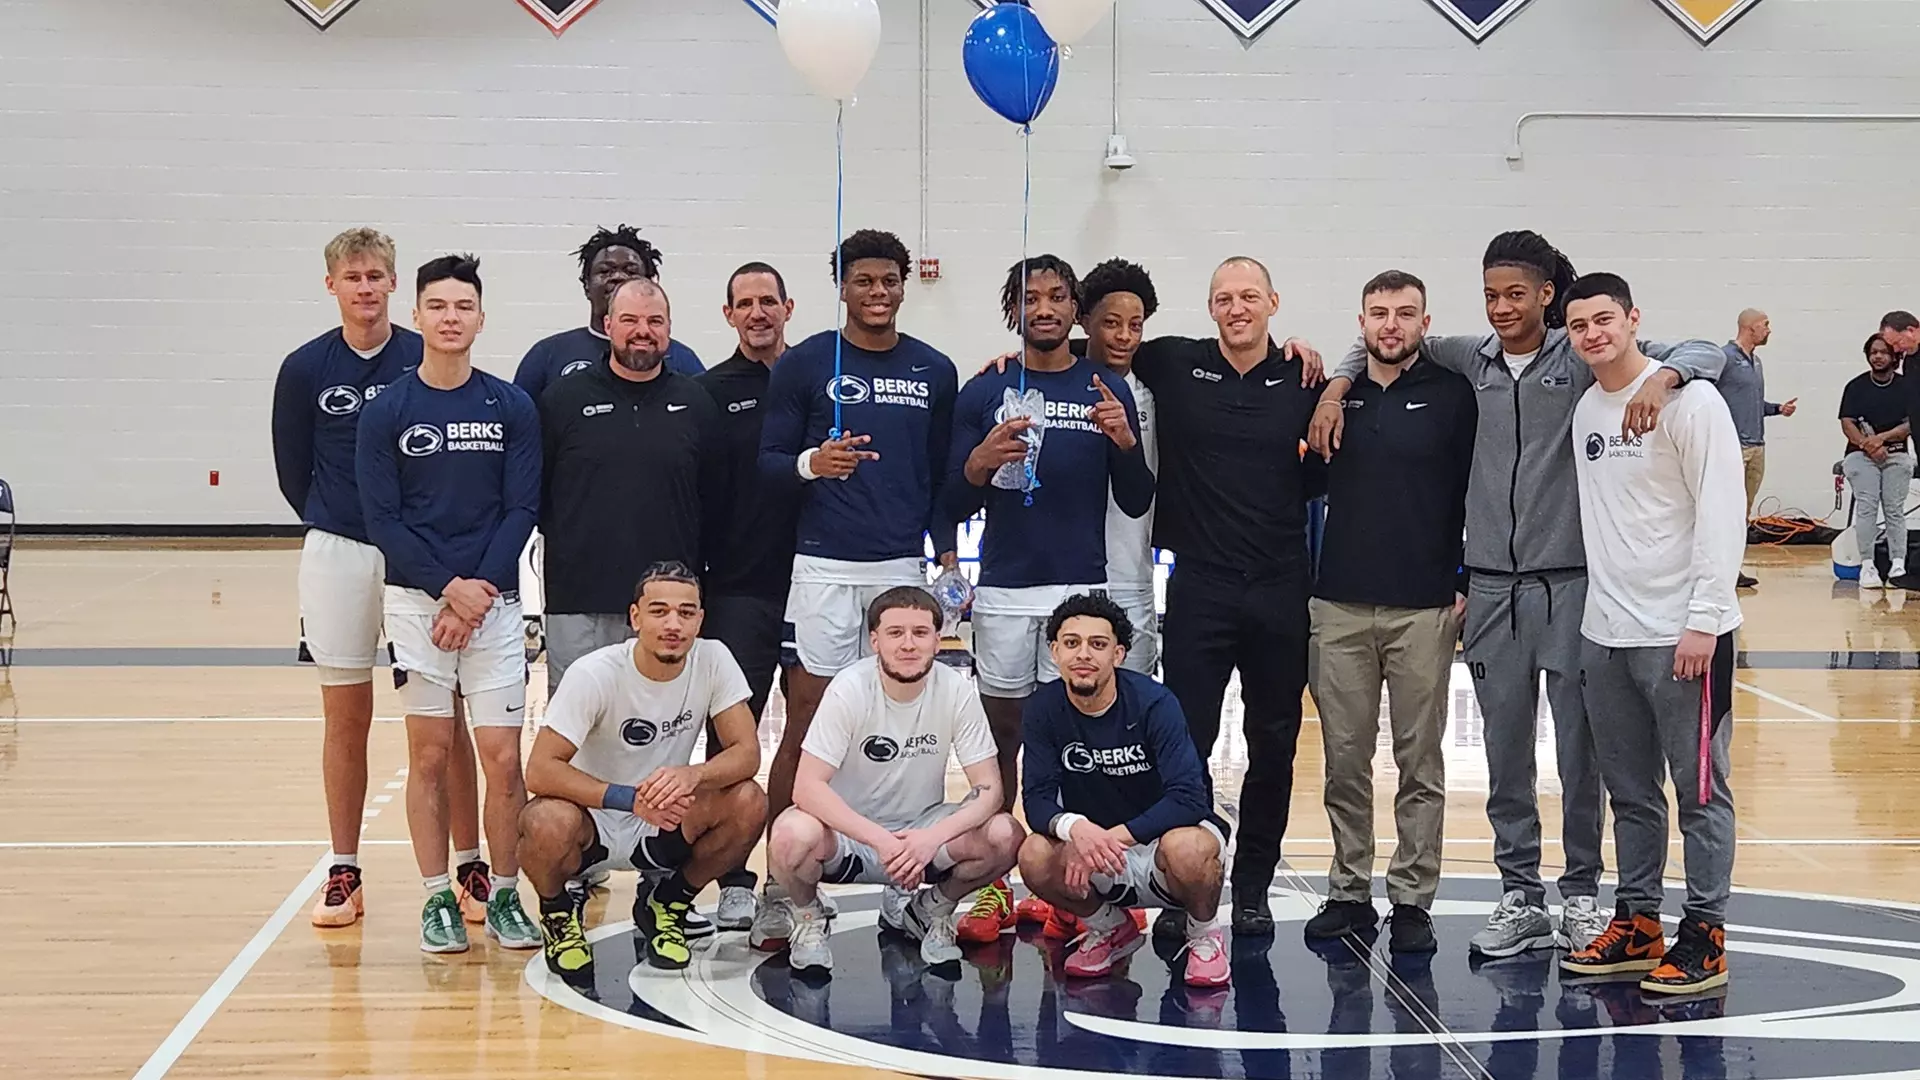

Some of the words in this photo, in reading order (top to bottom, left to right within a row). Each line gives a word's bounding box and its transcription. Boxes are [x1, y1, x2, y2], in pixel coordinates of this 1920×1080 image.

[873, 378, 929, 397] BERKS
[1045, 401, 1096, 419] BERK
[446, 422, 503, 439] BERKS
[447, 440, 504, 452] BASKETBALL
[1470, 661, 1485, 680] 10
[1092, 744, 1146, 765] BERKS
[1102, 762, 1153, 776] ASKETBALL
